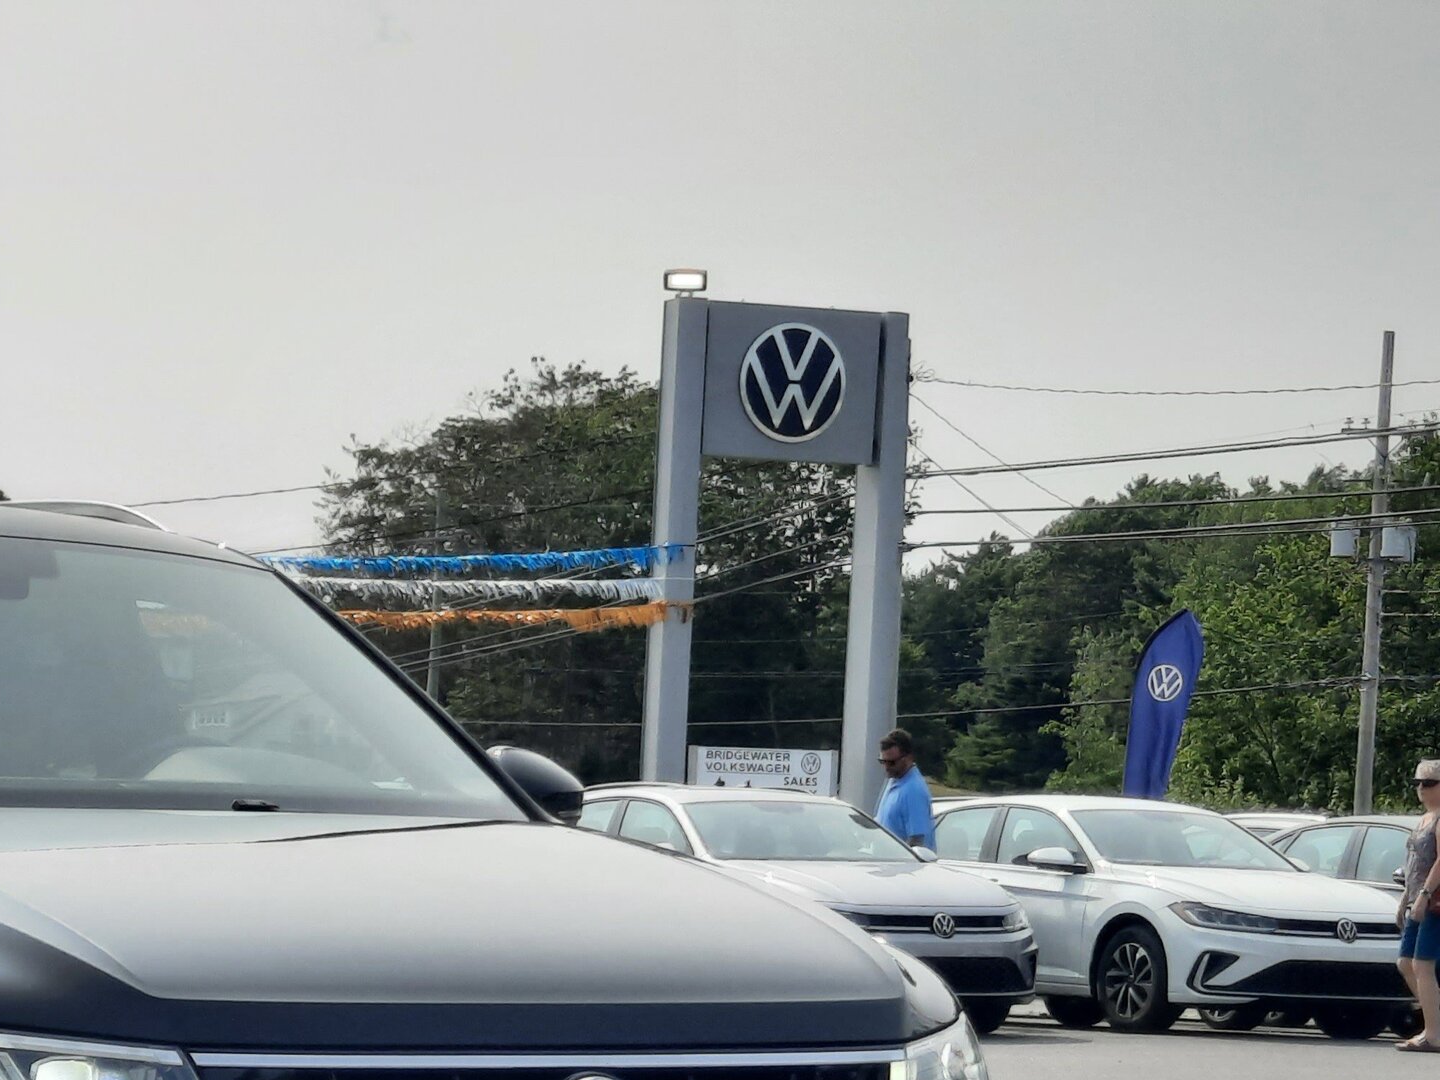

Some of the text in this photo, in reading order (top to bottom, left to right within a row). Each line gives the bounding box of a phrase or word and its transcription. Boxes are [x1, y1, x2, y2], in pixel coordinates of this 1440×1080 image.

[740, 322, 846, 442] VW
[1148, 665, 1182, 701] VW
[705, 750, 791, 762] BRIDGEWATER
[705, 761, 791, 773] VOLKSWAGEN
[783, 776, 818, 787] SALES
